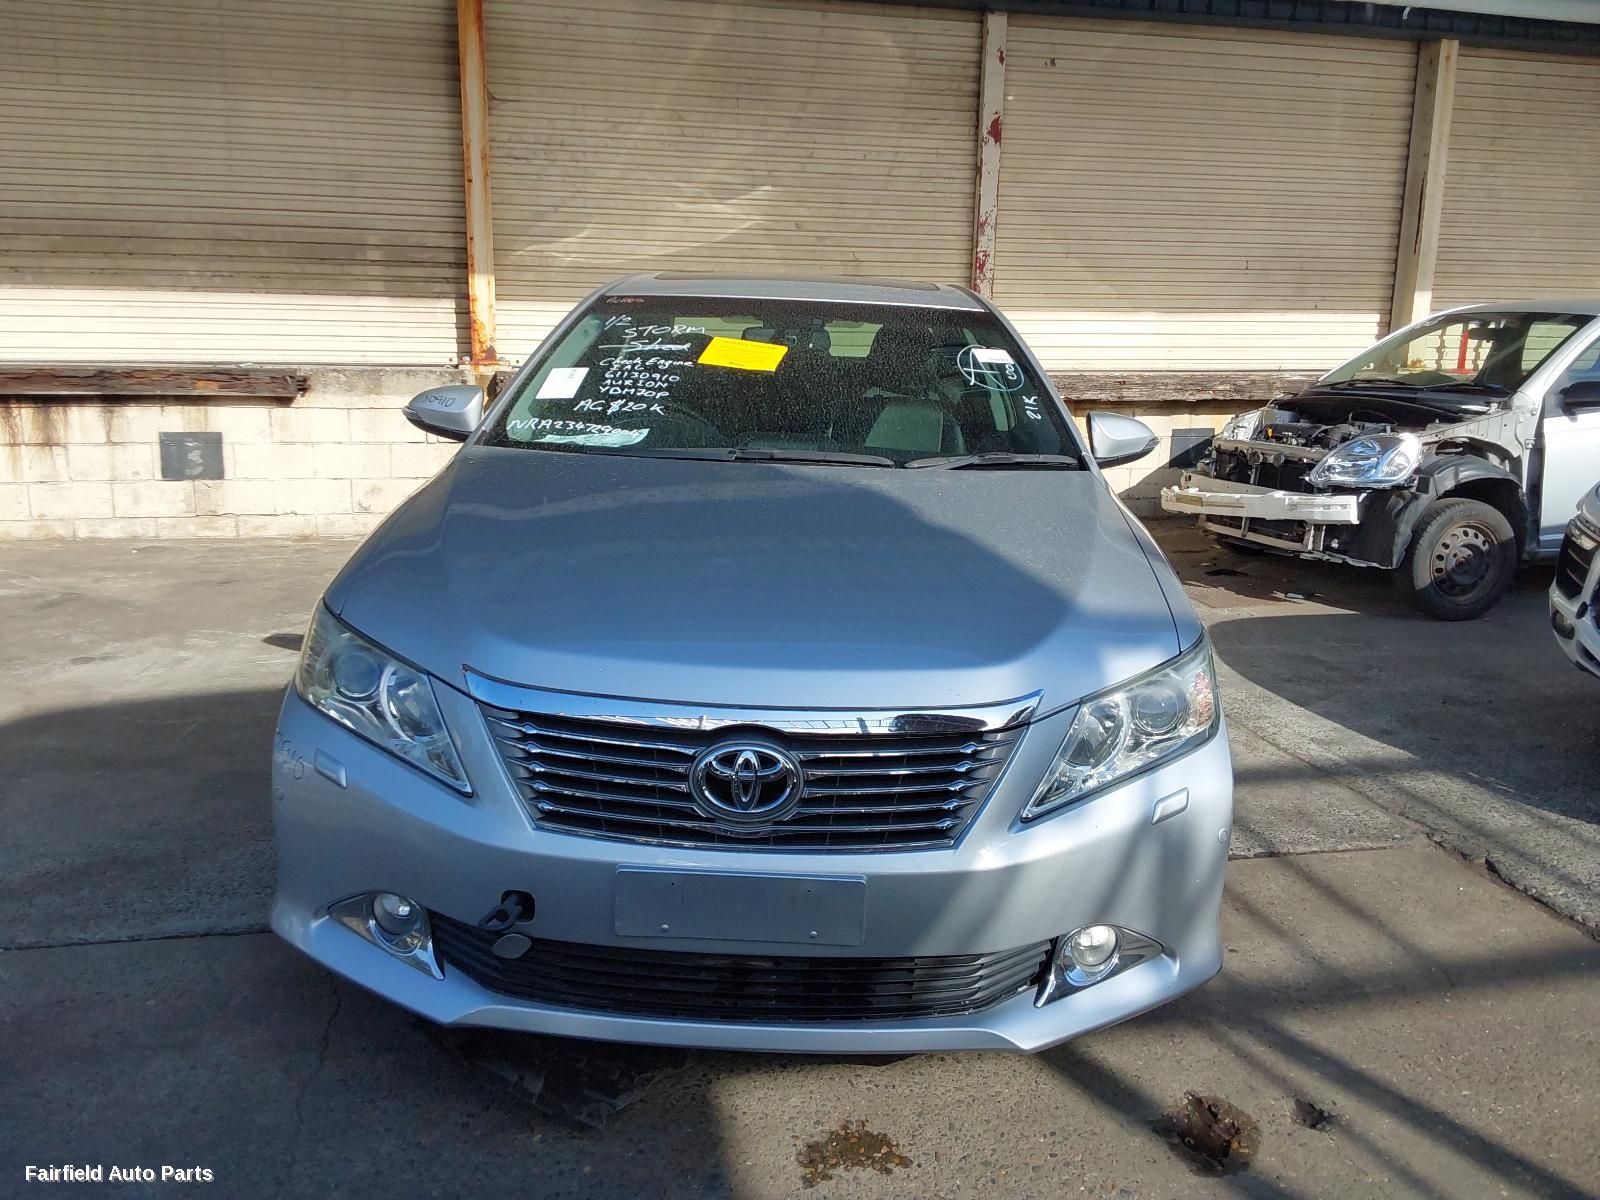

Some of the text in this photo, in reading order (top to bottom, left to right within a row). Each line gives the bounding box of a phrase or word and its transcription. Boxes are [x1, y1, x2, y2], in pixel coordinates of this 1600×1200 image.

[622, 325, 705, 338] STORM
[645, 357, 694, 369] Engine
[602, 379, 668, 388] AURION
